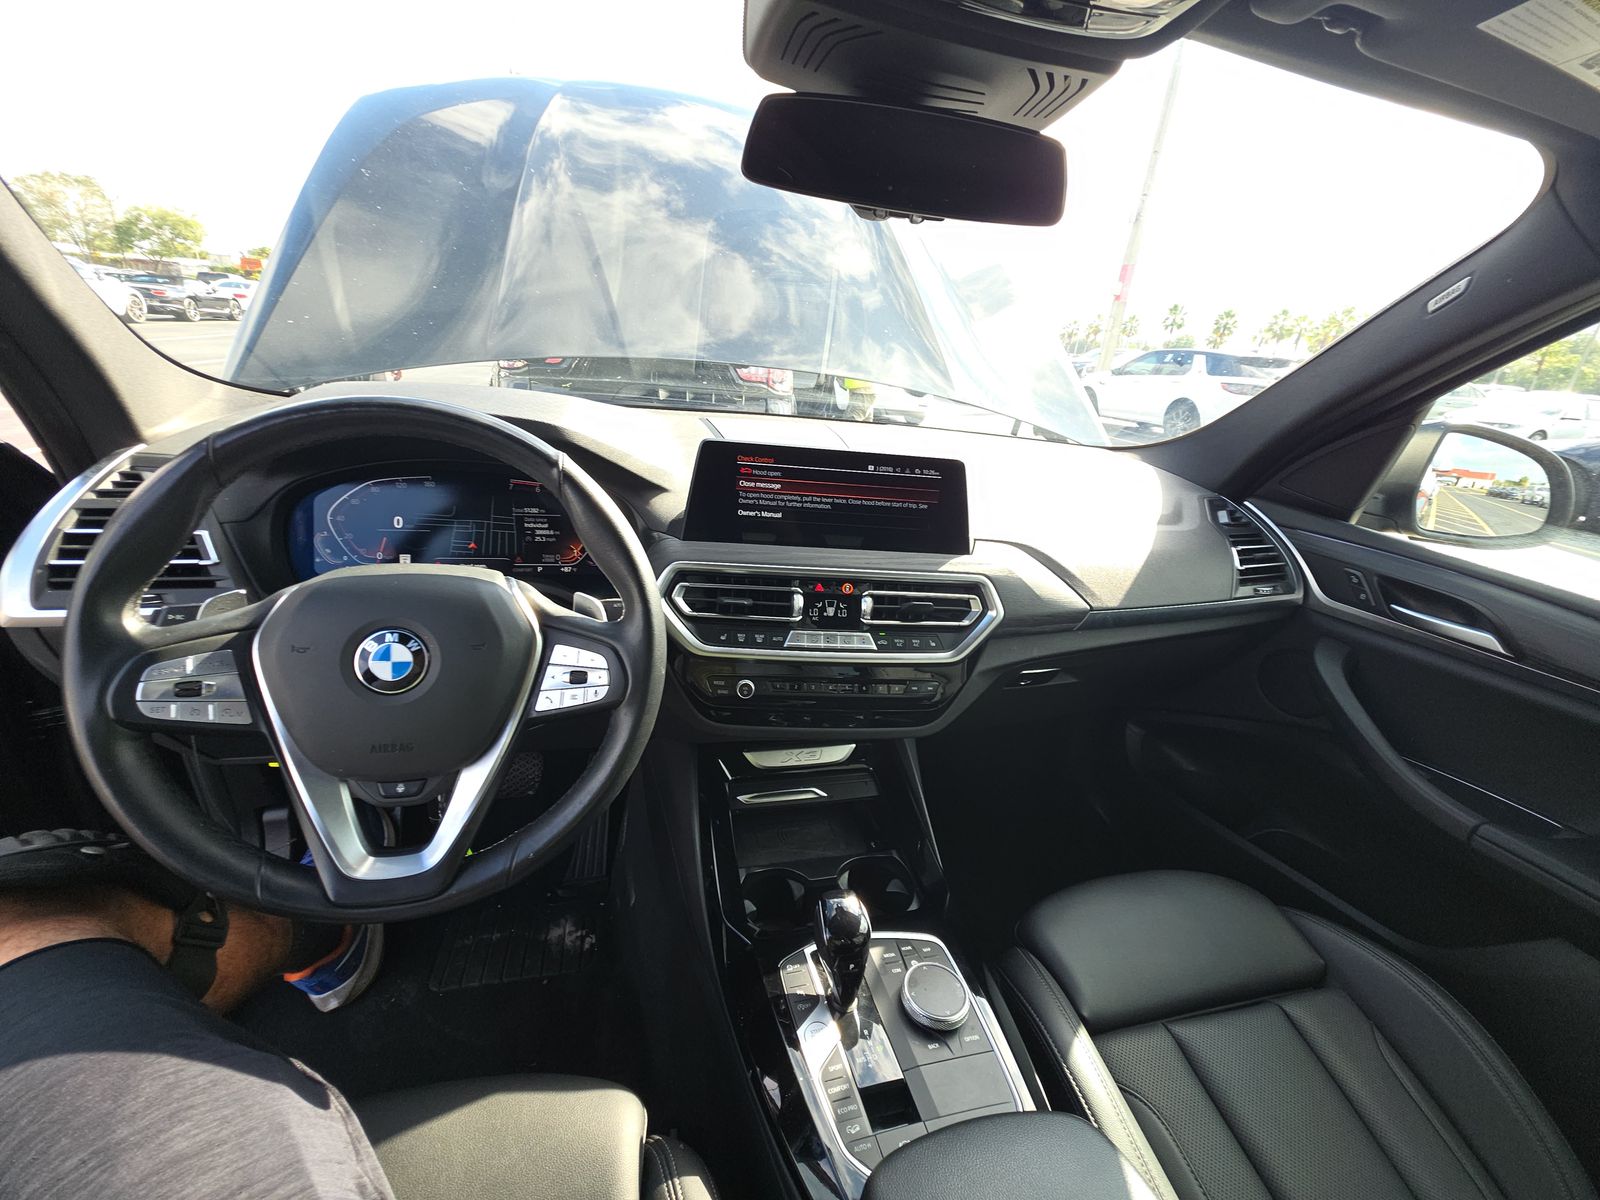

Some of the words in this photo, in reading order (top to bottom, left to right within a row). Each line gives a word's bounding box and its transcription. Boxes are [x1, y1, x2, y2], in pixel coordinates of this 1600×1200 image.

[756, 482, 782, 490] message
[393, 516, 404, 528] 0
[364, 633, 421, 653] BMW
[369, 743, 415, 754] AIRBAG
[780, 749, 822, 764] X3
[828, 1084, 850, 1094] COMFORT
[838, 1107, 848, 1115] ECO
[848, 1104, 858, 1112] PRO
[854, 1144, 867, 1152] AUTO
